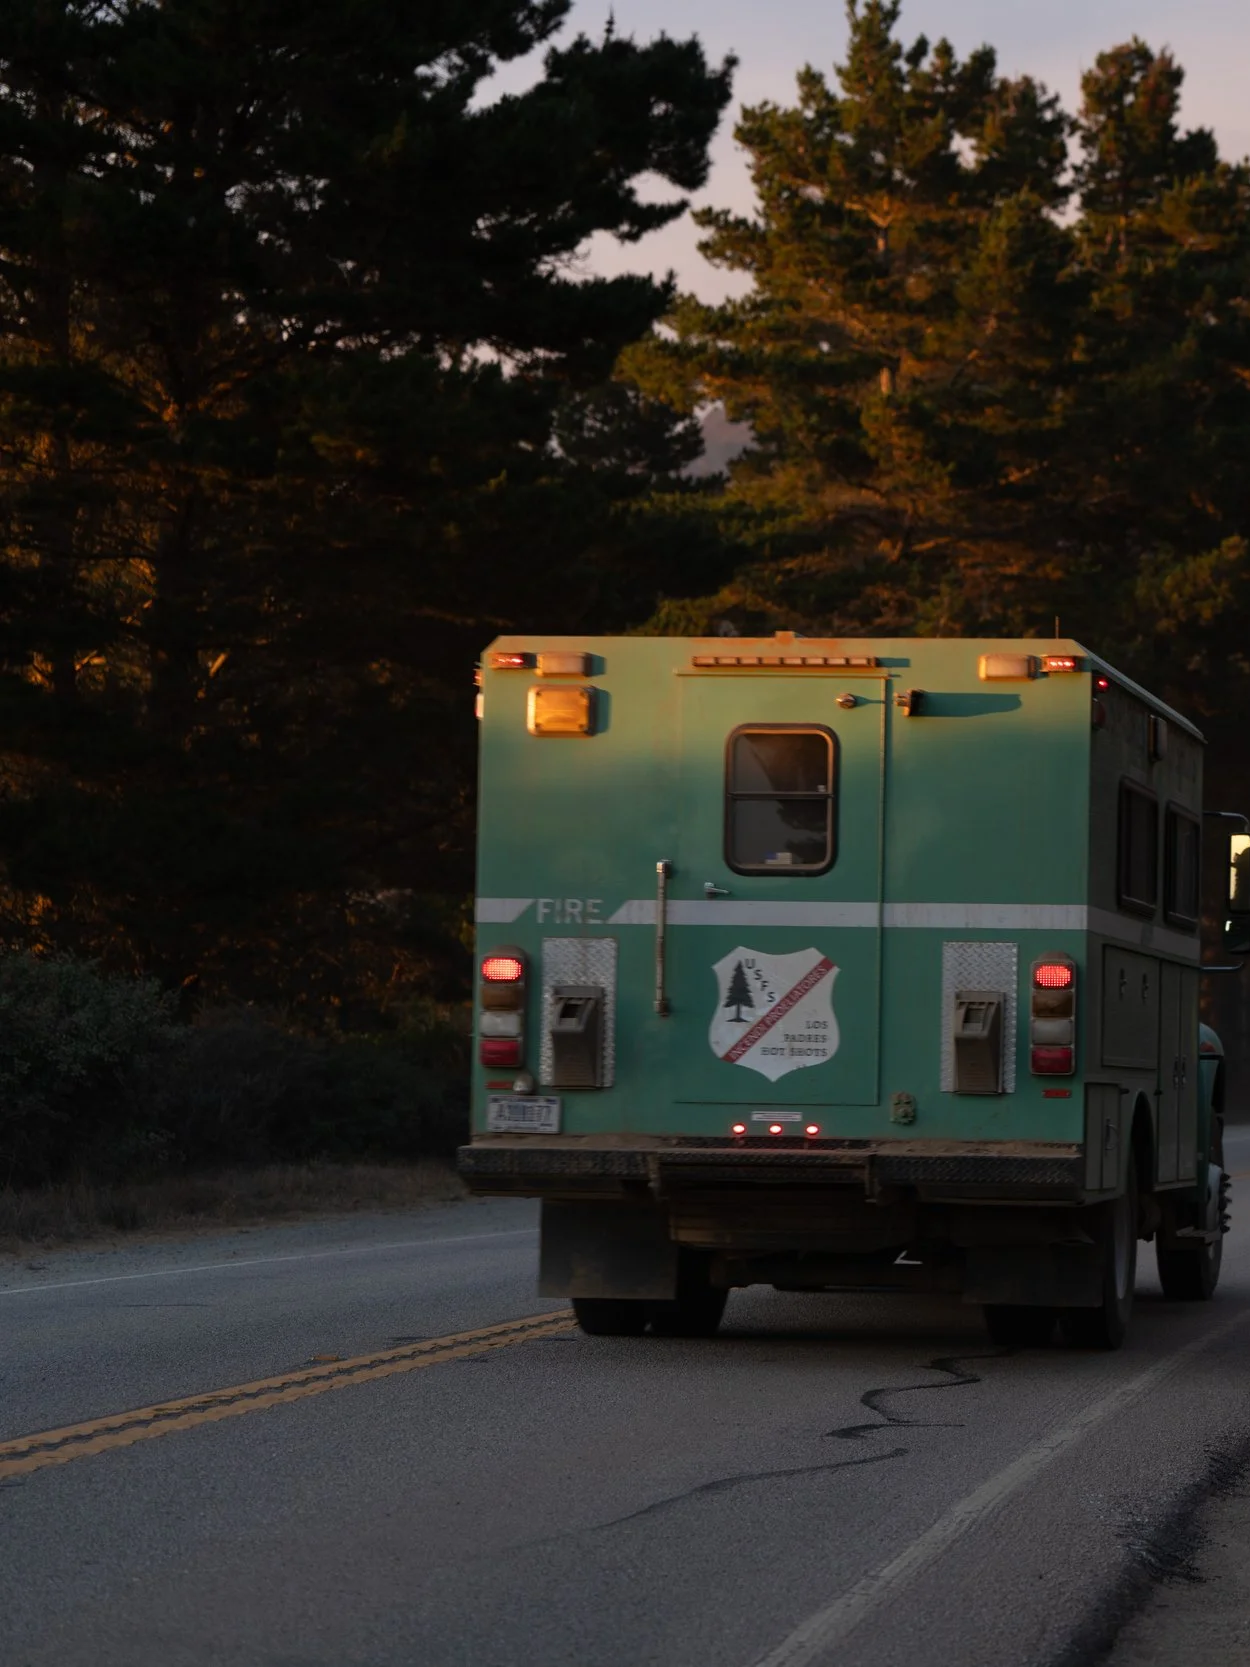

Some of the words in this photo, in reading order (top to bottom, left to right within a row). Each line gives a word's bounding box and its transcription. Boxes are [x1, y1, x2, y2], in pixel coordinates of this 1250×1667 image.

[536, 898, 604, 924] FIRE
[806, 1020, 828, 1029] LOS
[783, 1033, 828, 1043] PADRES
[760, 1047, 785, 1056] HOT
[789, 1047, 828, 1057] SHOTS
